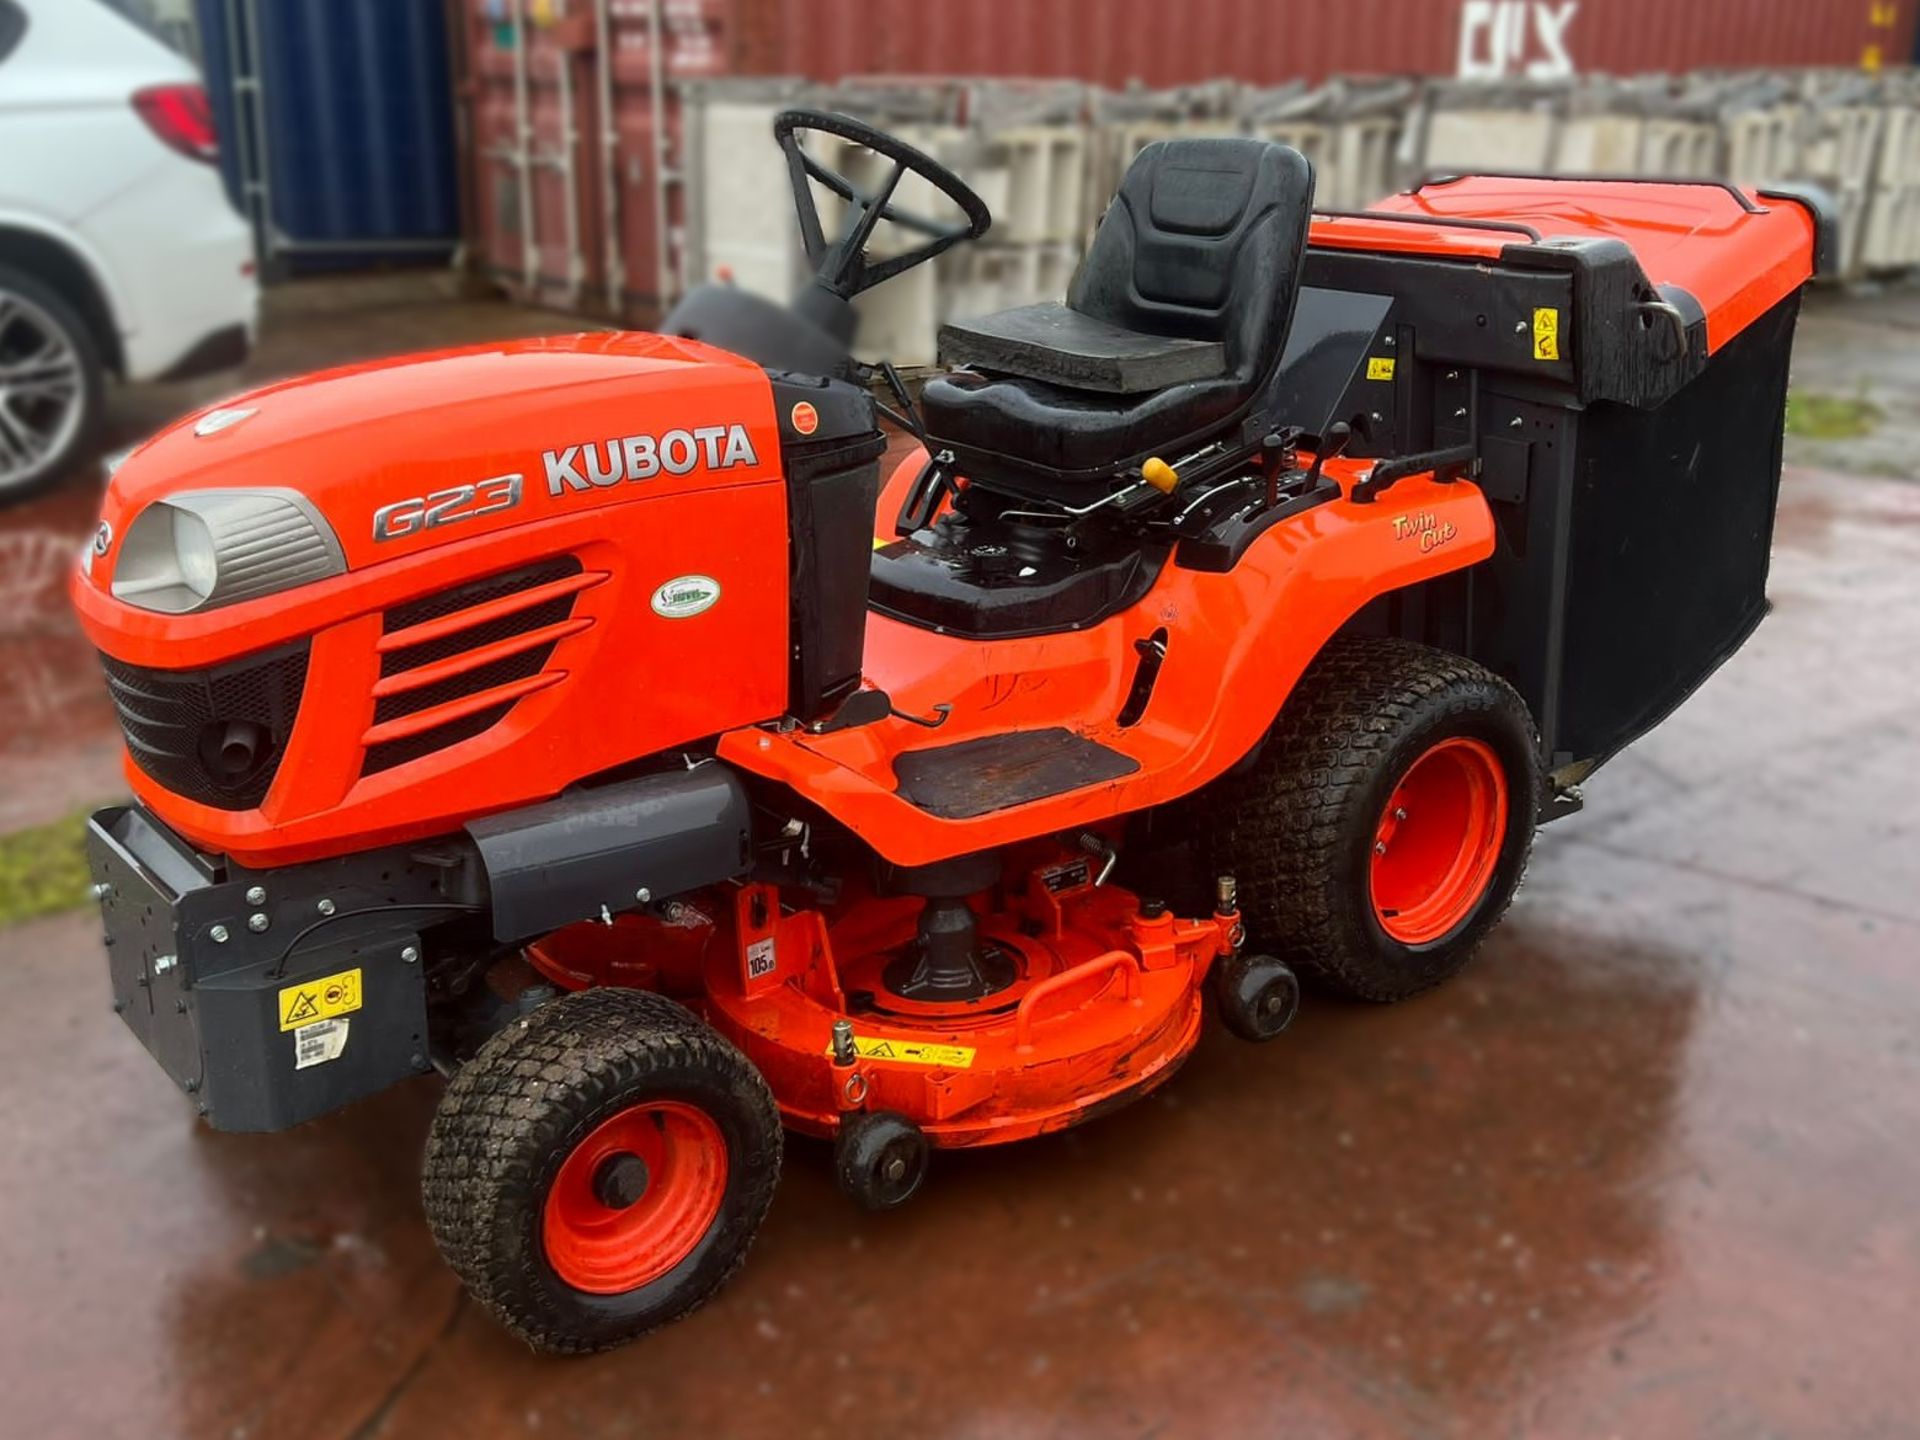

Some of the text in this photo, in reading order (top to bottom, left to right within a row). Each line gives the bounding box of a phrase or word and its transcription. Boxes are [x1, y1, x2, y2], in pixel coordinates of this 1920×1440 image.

[541, 423, 759, 497] KUBOTA
[372, 472, 525, 543] G23
[1392, 511, 1437, 541] Twin
[1420, 522, 1458, 554] Cut
[750, 954, 769, 976] 105
